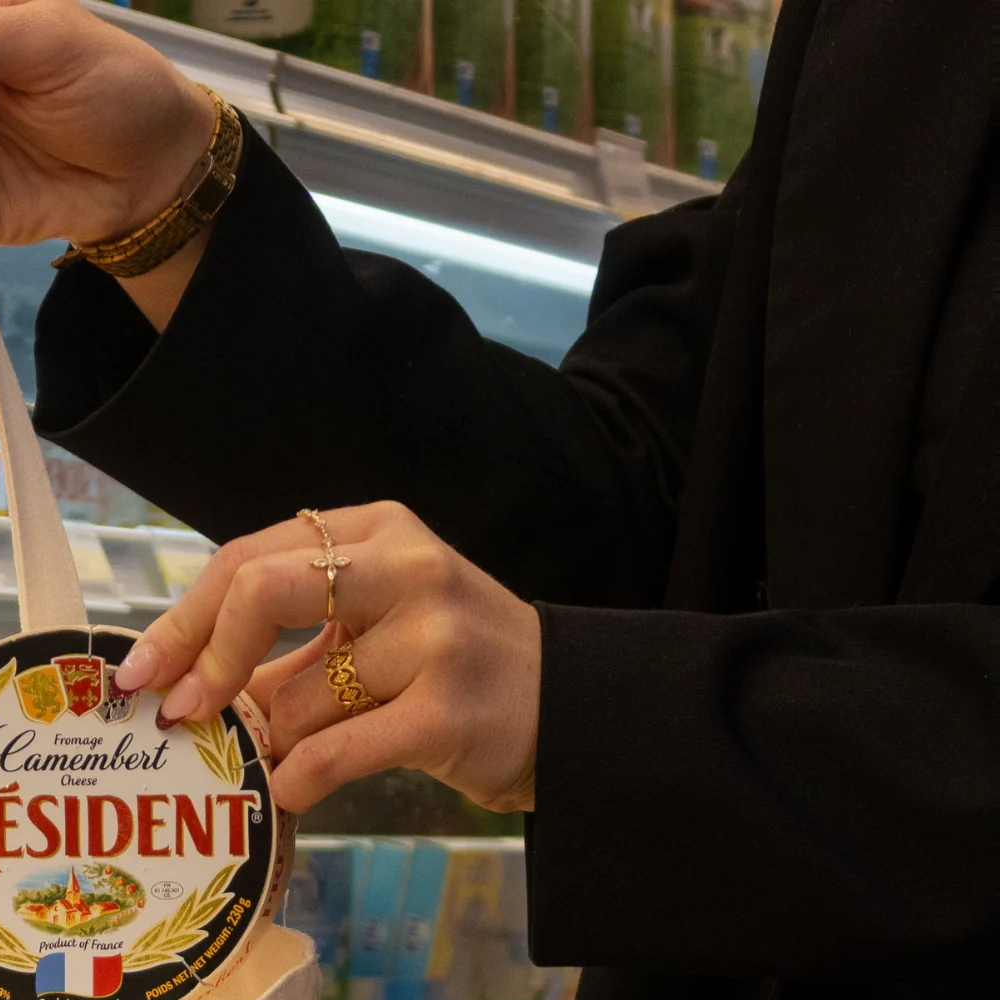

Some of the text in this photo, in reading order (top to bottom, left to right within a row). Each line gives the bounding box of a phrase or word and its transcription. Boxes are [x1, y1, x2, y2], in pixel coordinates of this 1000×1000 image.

[54, 733, 103, 750] Fromage
[60, 773, 98, 787] Cheese
[39, 937, 124, 953] Product of France
[145, 981, 174, 1000] POIDS
[203, 925, 235, 960] WEIGHT:
[226, 903, 245, 927] 230
